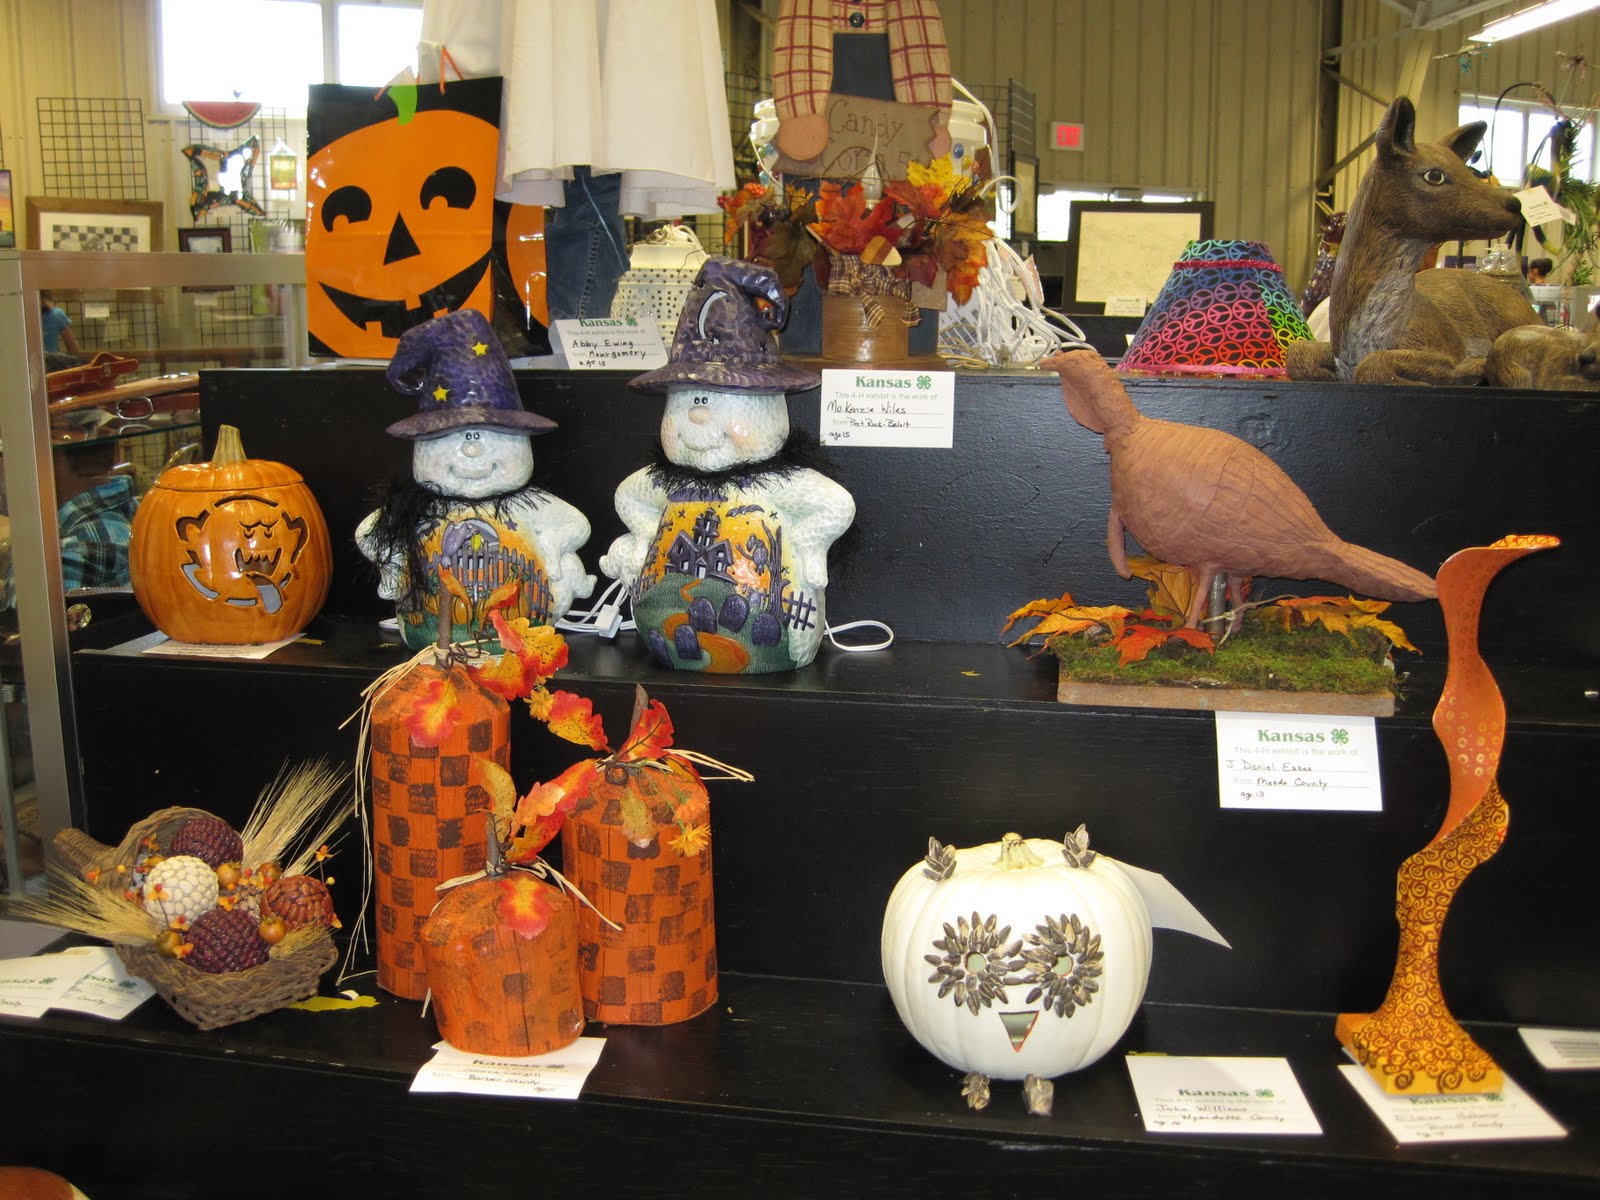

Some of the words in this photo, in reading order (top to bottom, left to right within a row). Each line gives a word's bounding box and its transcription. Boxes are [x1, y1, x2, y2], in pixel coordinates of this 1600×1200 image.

[829, 98, 904, 147] Candy
[579, 317, 623, 327] Kansas
[572, 339, 598, 350] Abby
[603, 338, 634, 349] Ewing
[855, 375, 912, 389] Kansas
[834, 391, 850, 399] This
[850, 391, 865, 399] 4-H
[865, 392, 890, 400] exhibit
[898, 392, 910, 400] the
[911, 393, 929, 401] work
[930, 393, 938, 401] of
[832, 418, 848, 426] from
[1257, 729, 1326, 743] Kansas
[1234, 746, 1252, 754] This
[1253, 746, 1270, 755] 4-H
[1271, 747, 1300, 755] exhibit
[1301, 748, 1310, 756] is
[1311, 748, 1325, 756] the
[1327, 748, 1347, 757] work
[1349, 748, 1359, 757] of
[1240, 759, 1275, 772] Daniel
[1233, 777, 1253, 785] from
[1294, 777, 1328, 791] County
[472, 1059, 541, 1069] Kansas
[1177, 1087, 1250, 1098] Kansas
